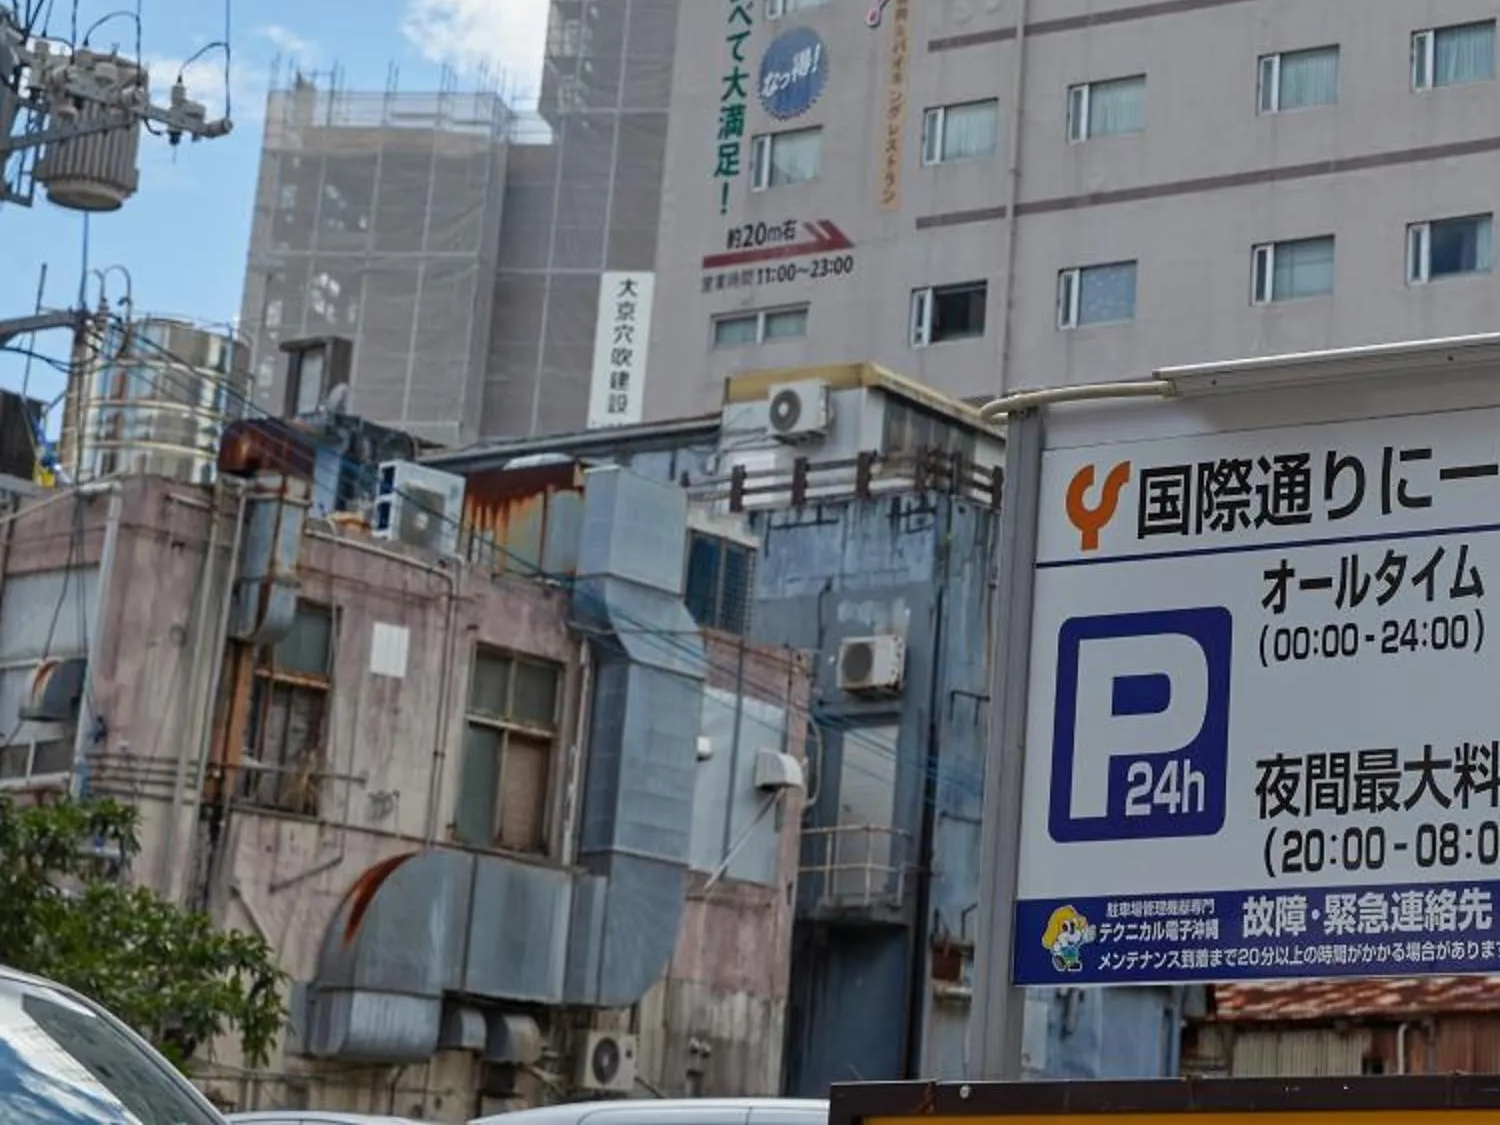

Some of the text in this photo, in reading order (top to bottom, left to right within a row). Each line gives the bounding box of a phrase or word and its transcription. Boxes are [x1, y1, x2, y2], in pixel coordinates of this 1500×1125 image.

[1260, 543, 1485, 615] オールタイム
[1069, 631, 1211, 820] P
[1124, 759, 1205, 817] 24h
[1099, 918, 1220, 943] テクニカル電子沖縄
[1241, 888, 1493, 938] 故障・緊急連絡先
